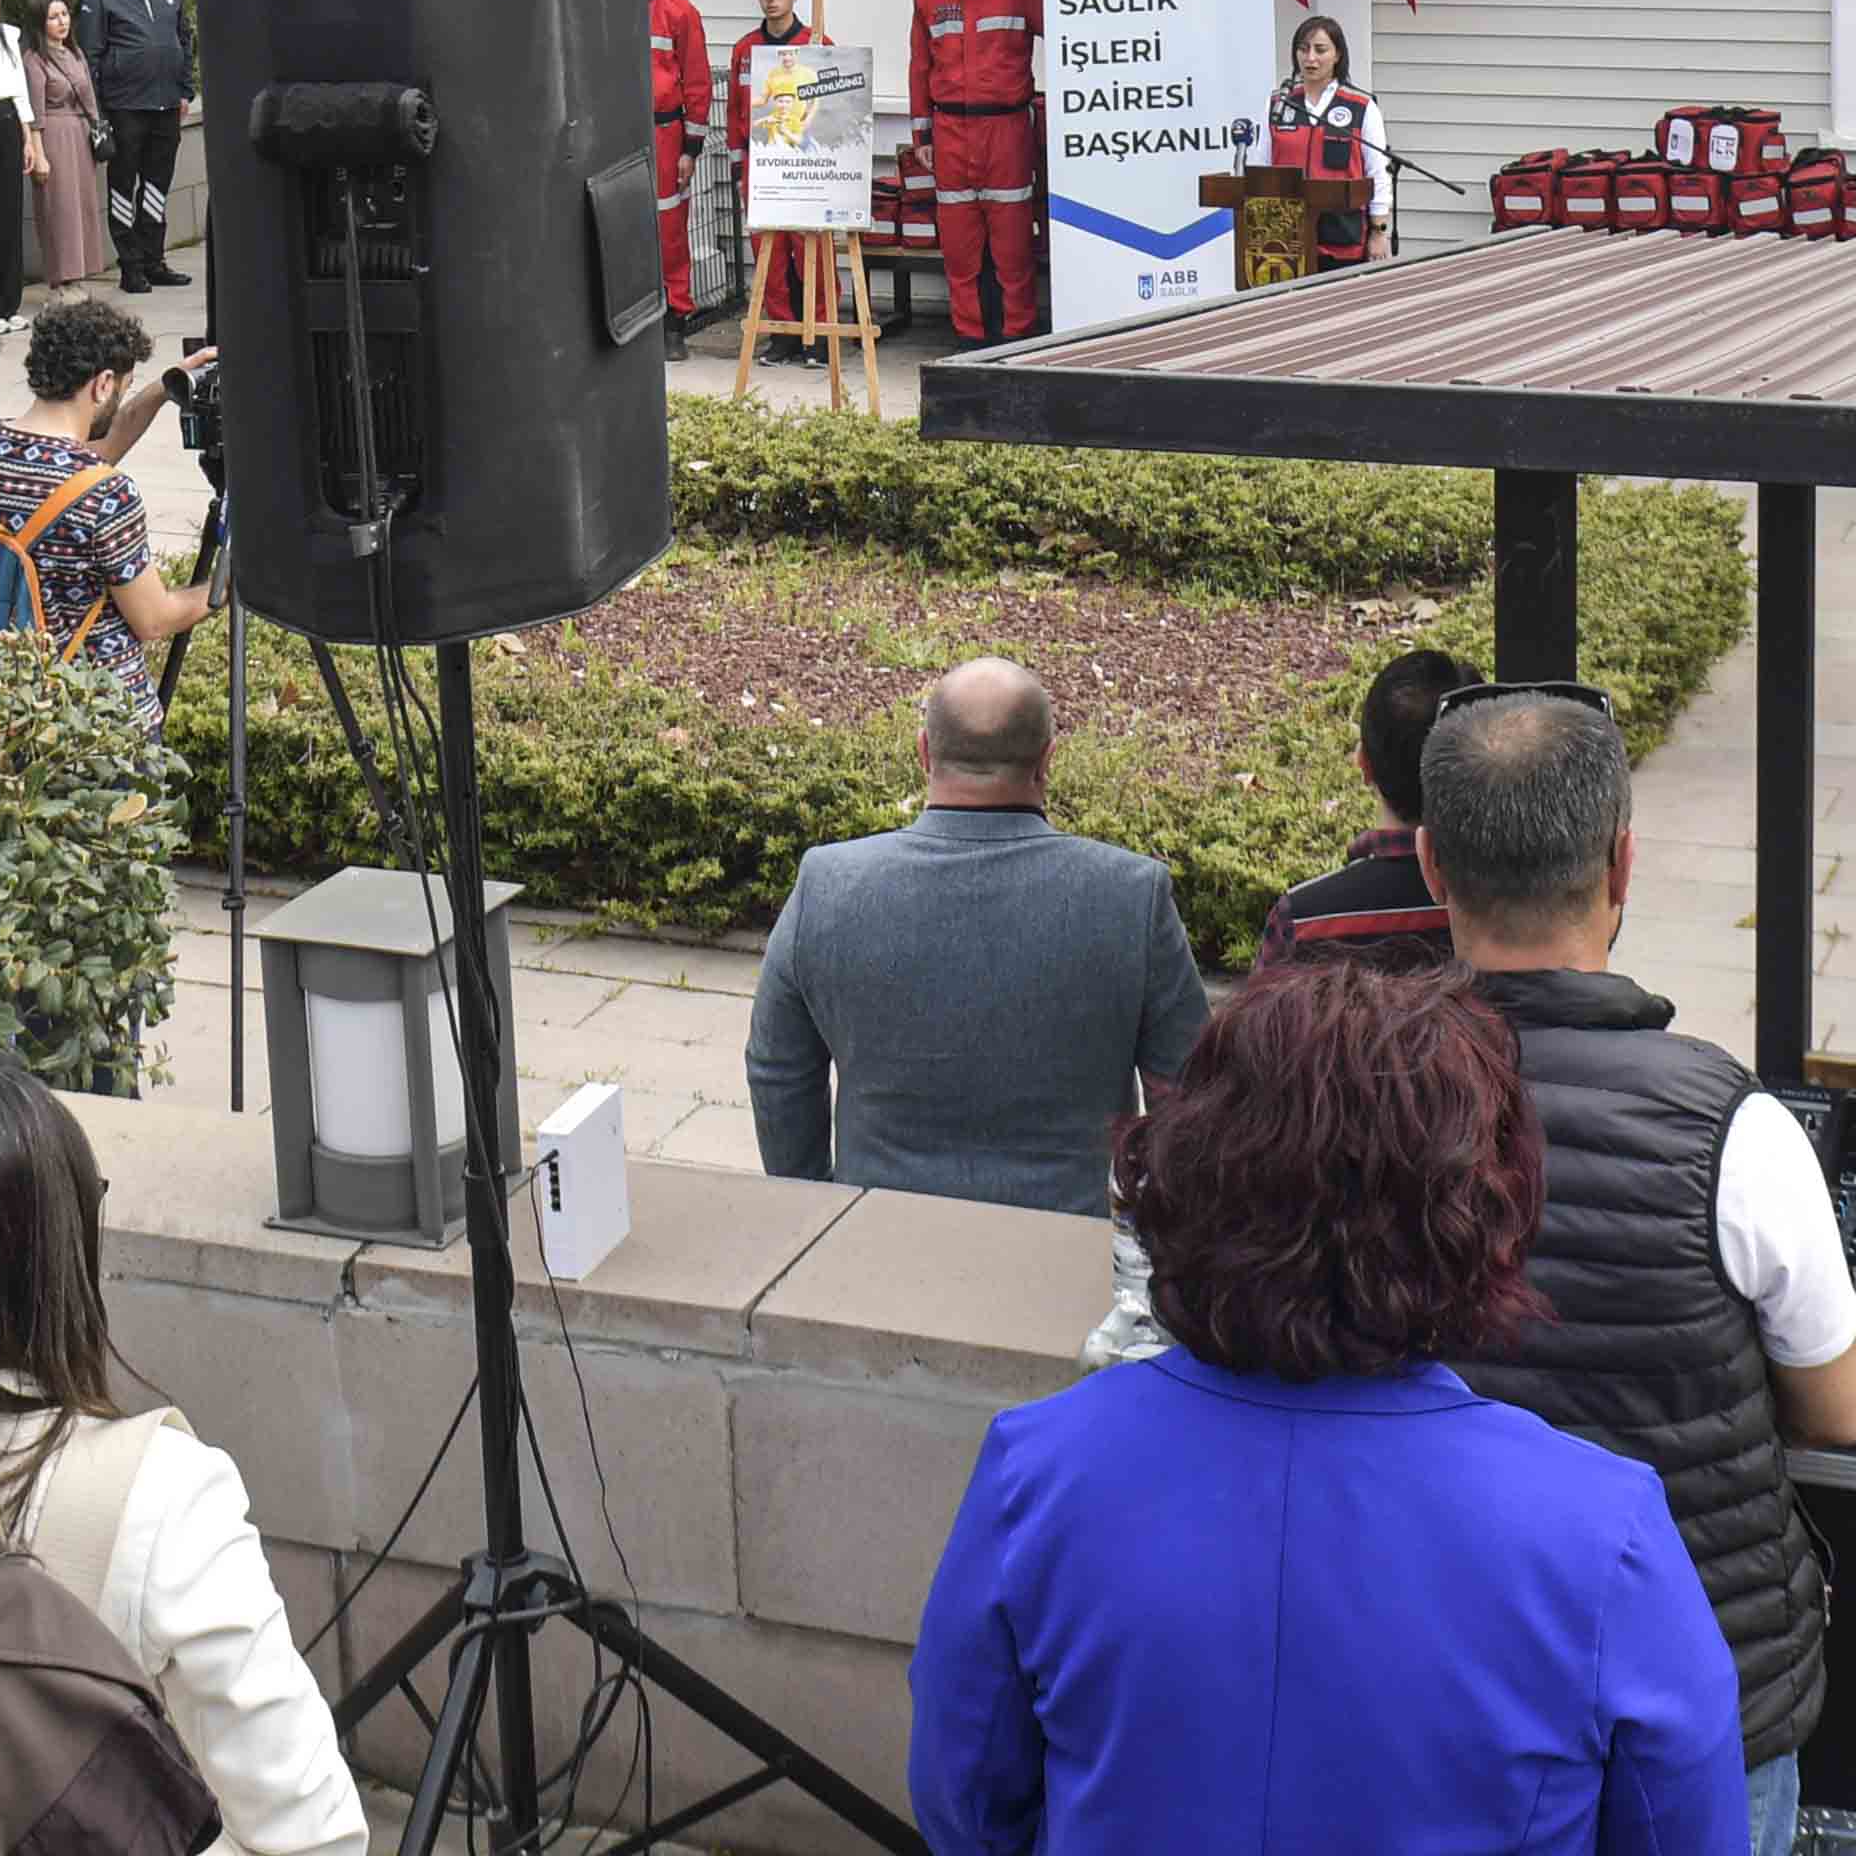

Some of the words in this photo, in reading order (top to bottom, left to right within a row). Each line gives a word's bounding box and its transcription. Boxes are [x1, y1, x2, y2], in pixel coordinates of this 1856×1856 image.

[1060, 30, 1162, 73] İŞLERİ
[1063, 76, 1194, 115] DAİRESİ
[1063, 123, 1261, 163] BAŞKANLII
[1159, 269, 1199, 285] ABB
